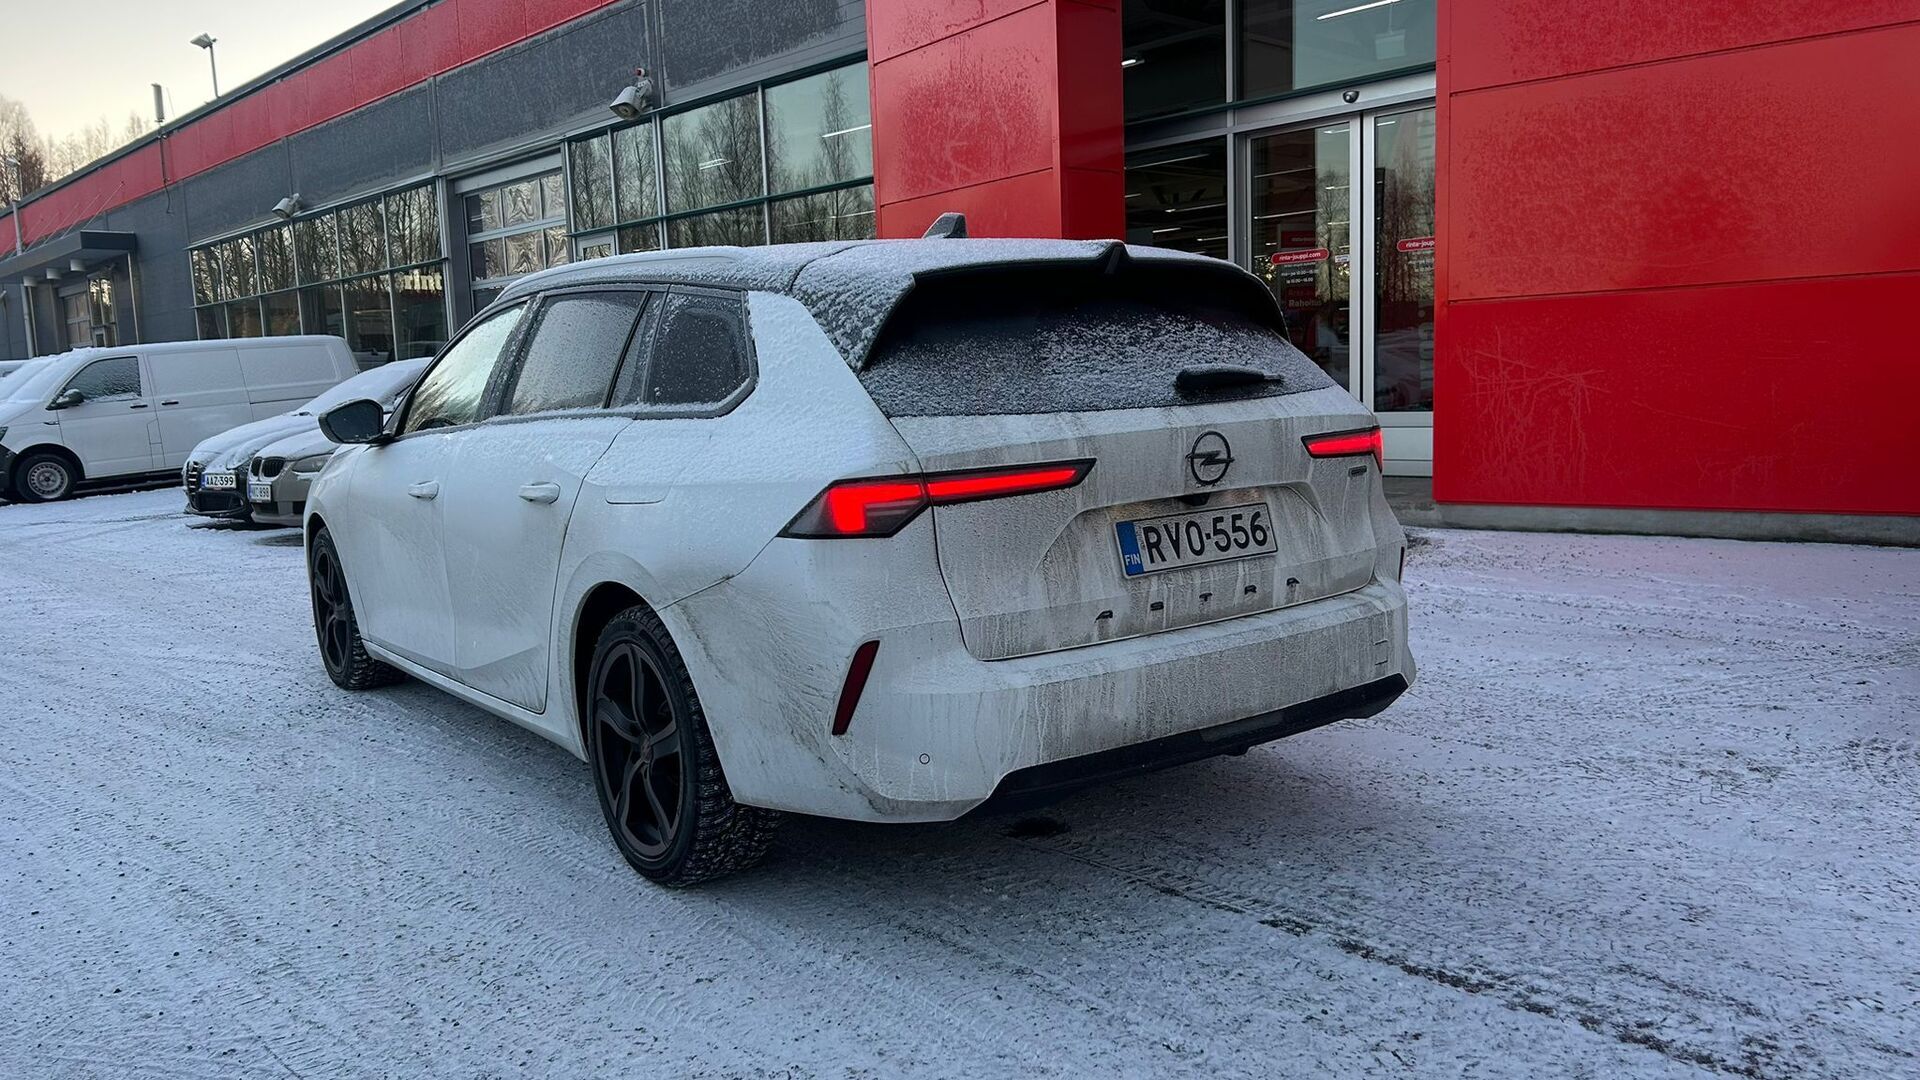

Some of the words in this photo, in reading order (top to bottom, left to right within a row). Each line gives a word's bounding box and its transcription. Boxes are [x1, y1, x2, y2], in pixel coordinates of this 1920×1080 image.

[1279, 252, 1321, 261] rinta-jouppi.com
[206, 476, 234, 486] AAZ-399
[1142, 511, 1268, 564] RVO-556
[1125, 553, 1142, 566] FIN
